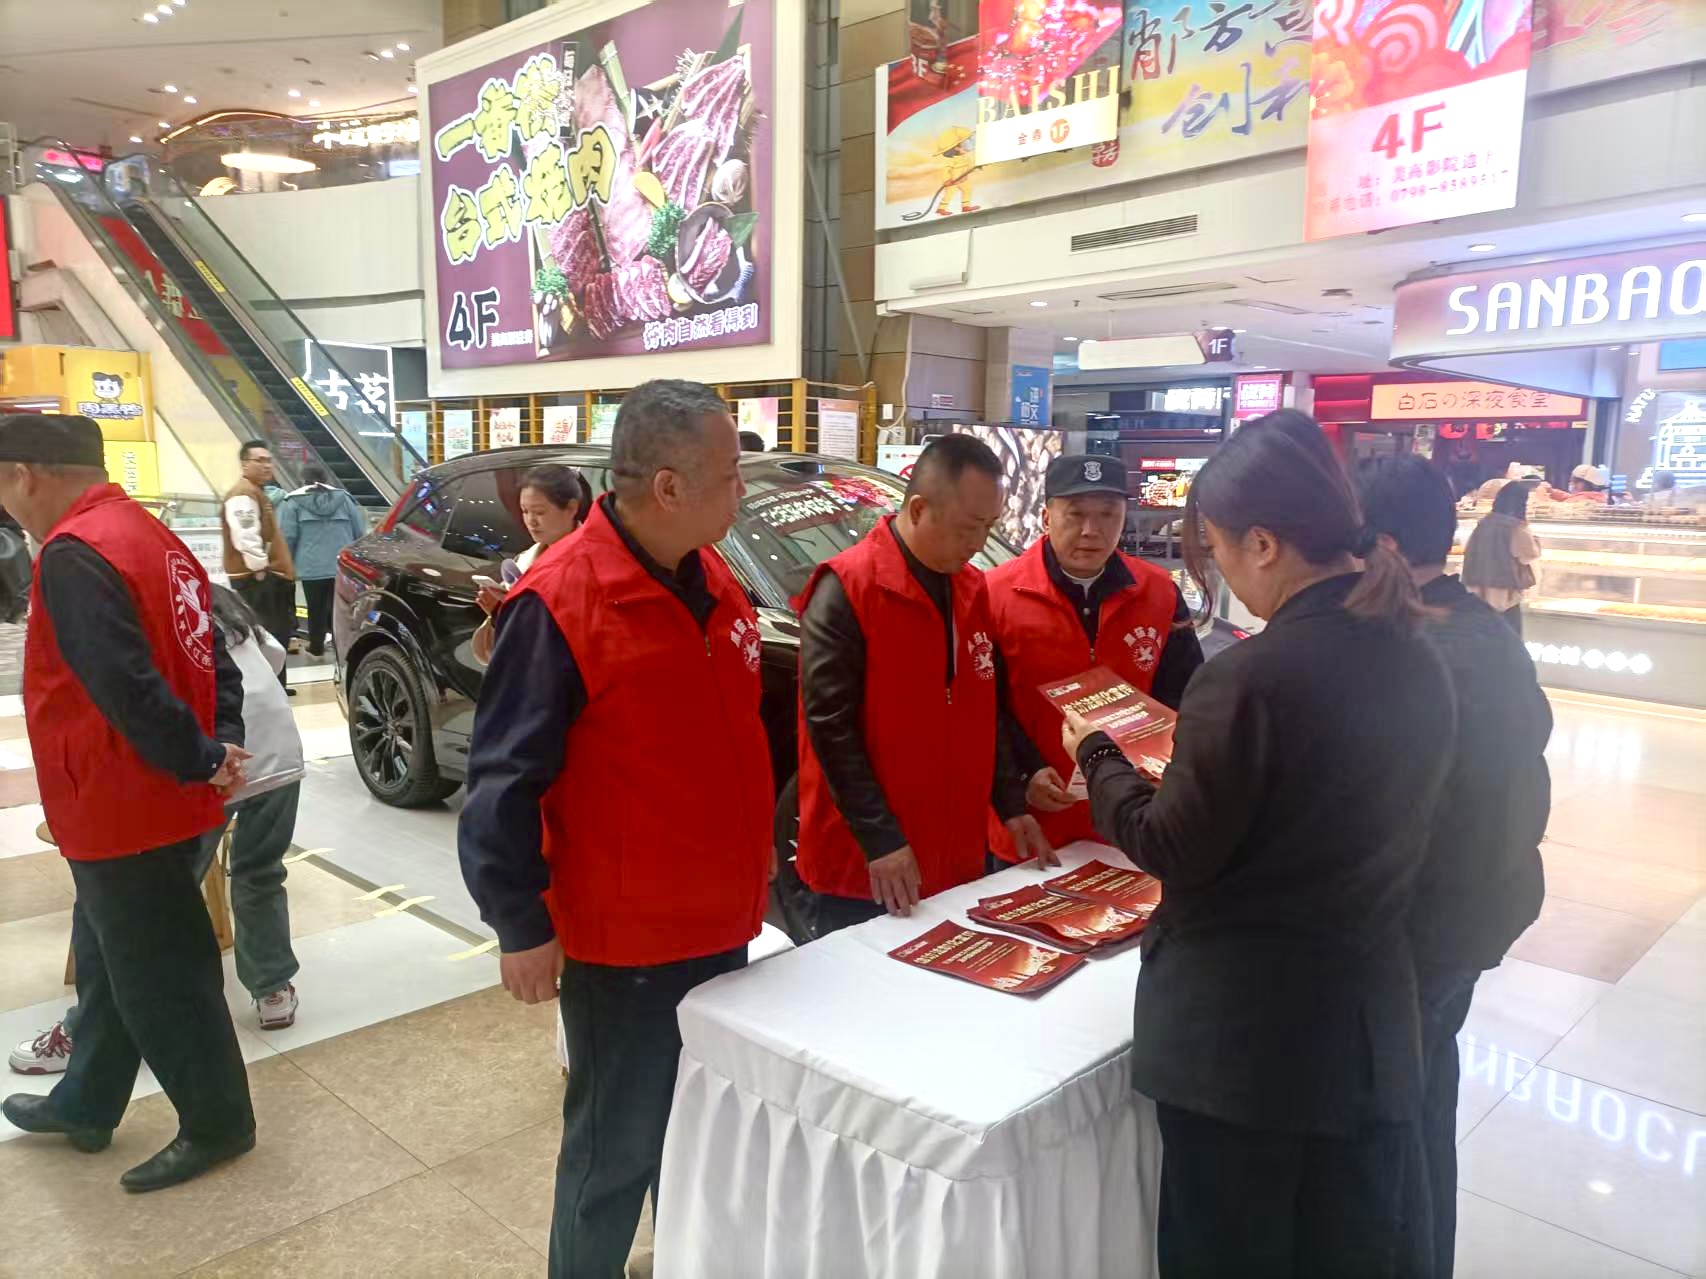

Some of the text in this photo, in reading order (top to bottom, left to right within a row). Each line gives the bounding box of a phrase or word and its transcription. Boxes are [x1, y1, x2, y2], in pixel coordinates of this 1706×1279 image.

[977, 65, 1121, 124] BAISHI
[1372, 101, 1447, 161] 4F
[448, 287, 500, 351] 4F
[1446, 259, 1706, 337] SANBAO
[1208, 337, 1228, 355] 1F
[314, 368, 388, 415] 古茗
[1398, 388, 1550, 412] 白石の深夜食堂
